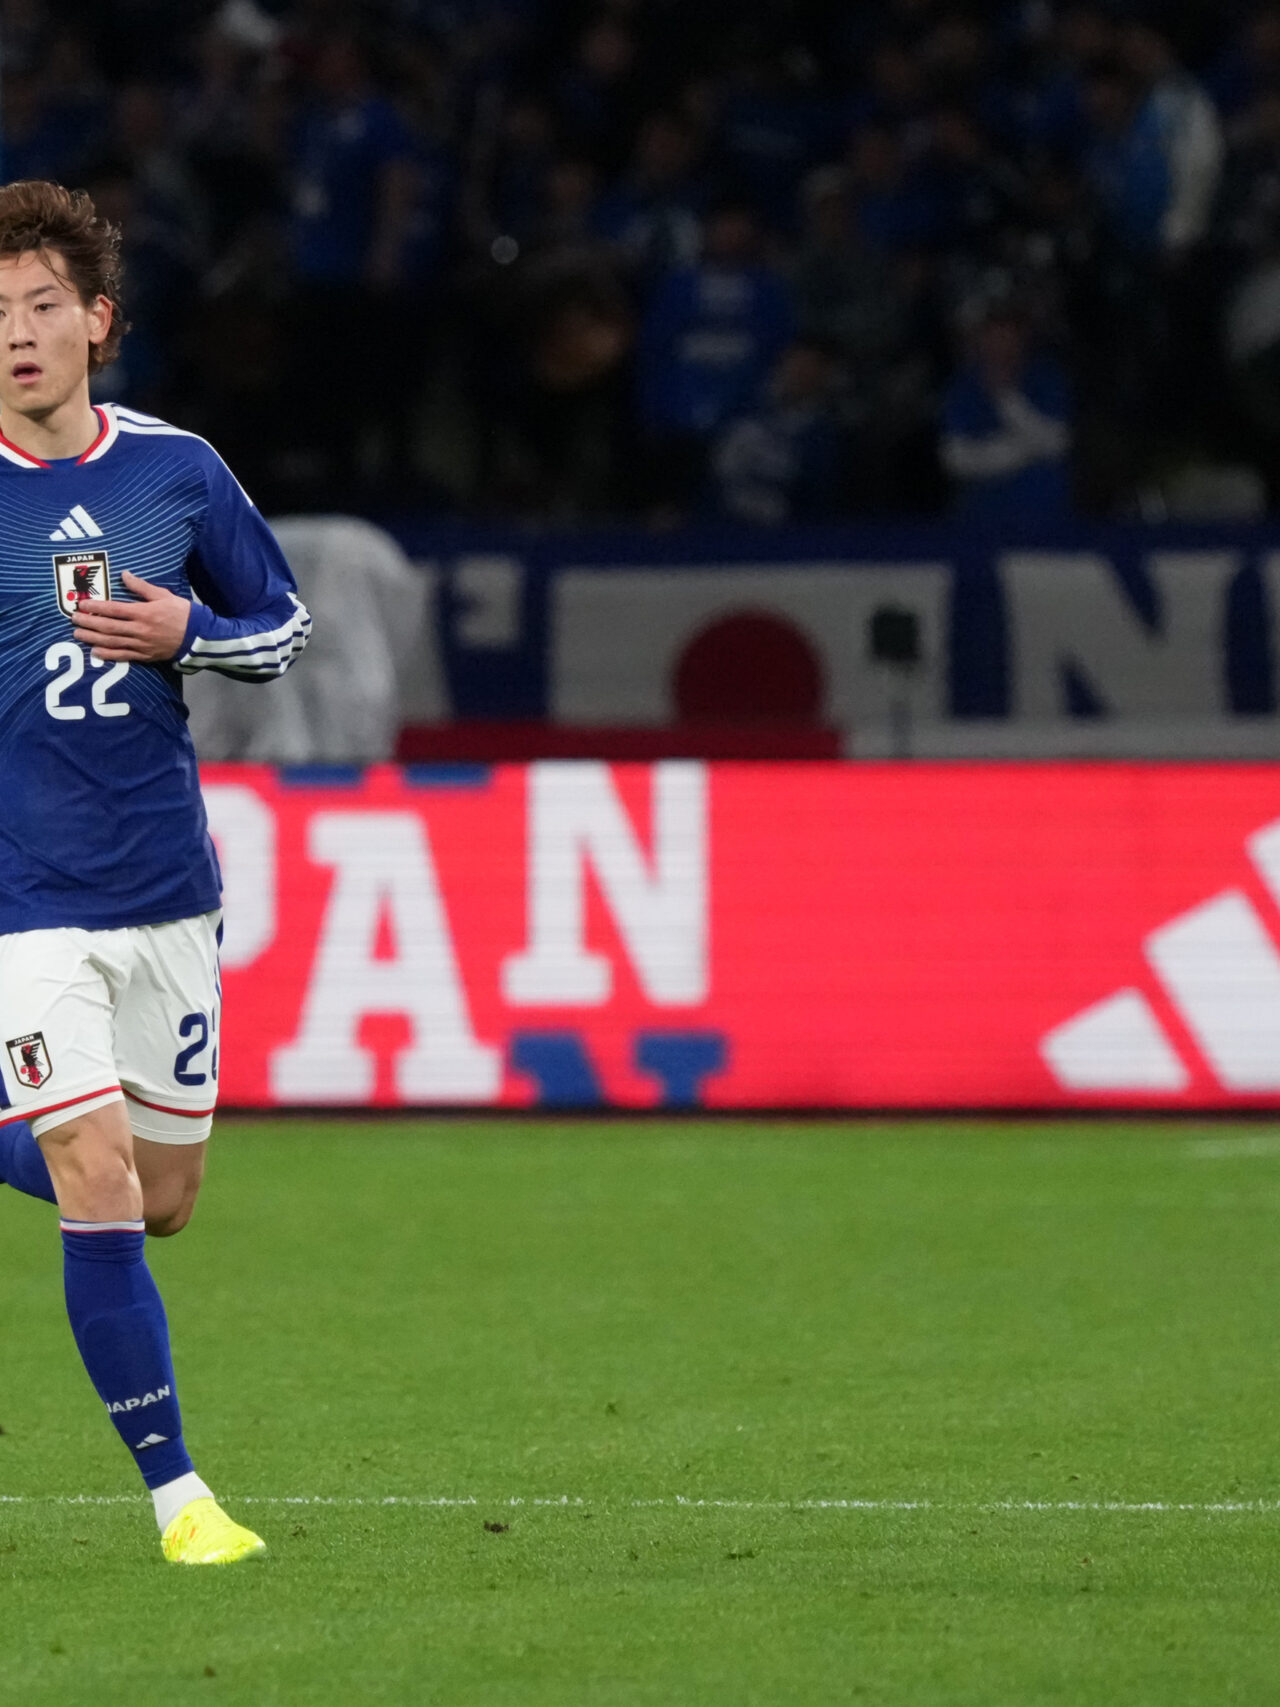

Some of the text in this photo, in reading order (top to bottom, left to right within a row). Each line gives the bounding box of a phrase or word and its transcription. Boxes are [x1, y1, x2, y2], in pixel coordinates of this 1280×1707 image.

[66, 554, 95, 563] JAPAN
[45, 641, 130, 720] 22
[14, 1035, 35, 1045] JAPAN
[173, 1007, 218, 1086] 2
[106, 1384, 171, 1413] JAPAN
